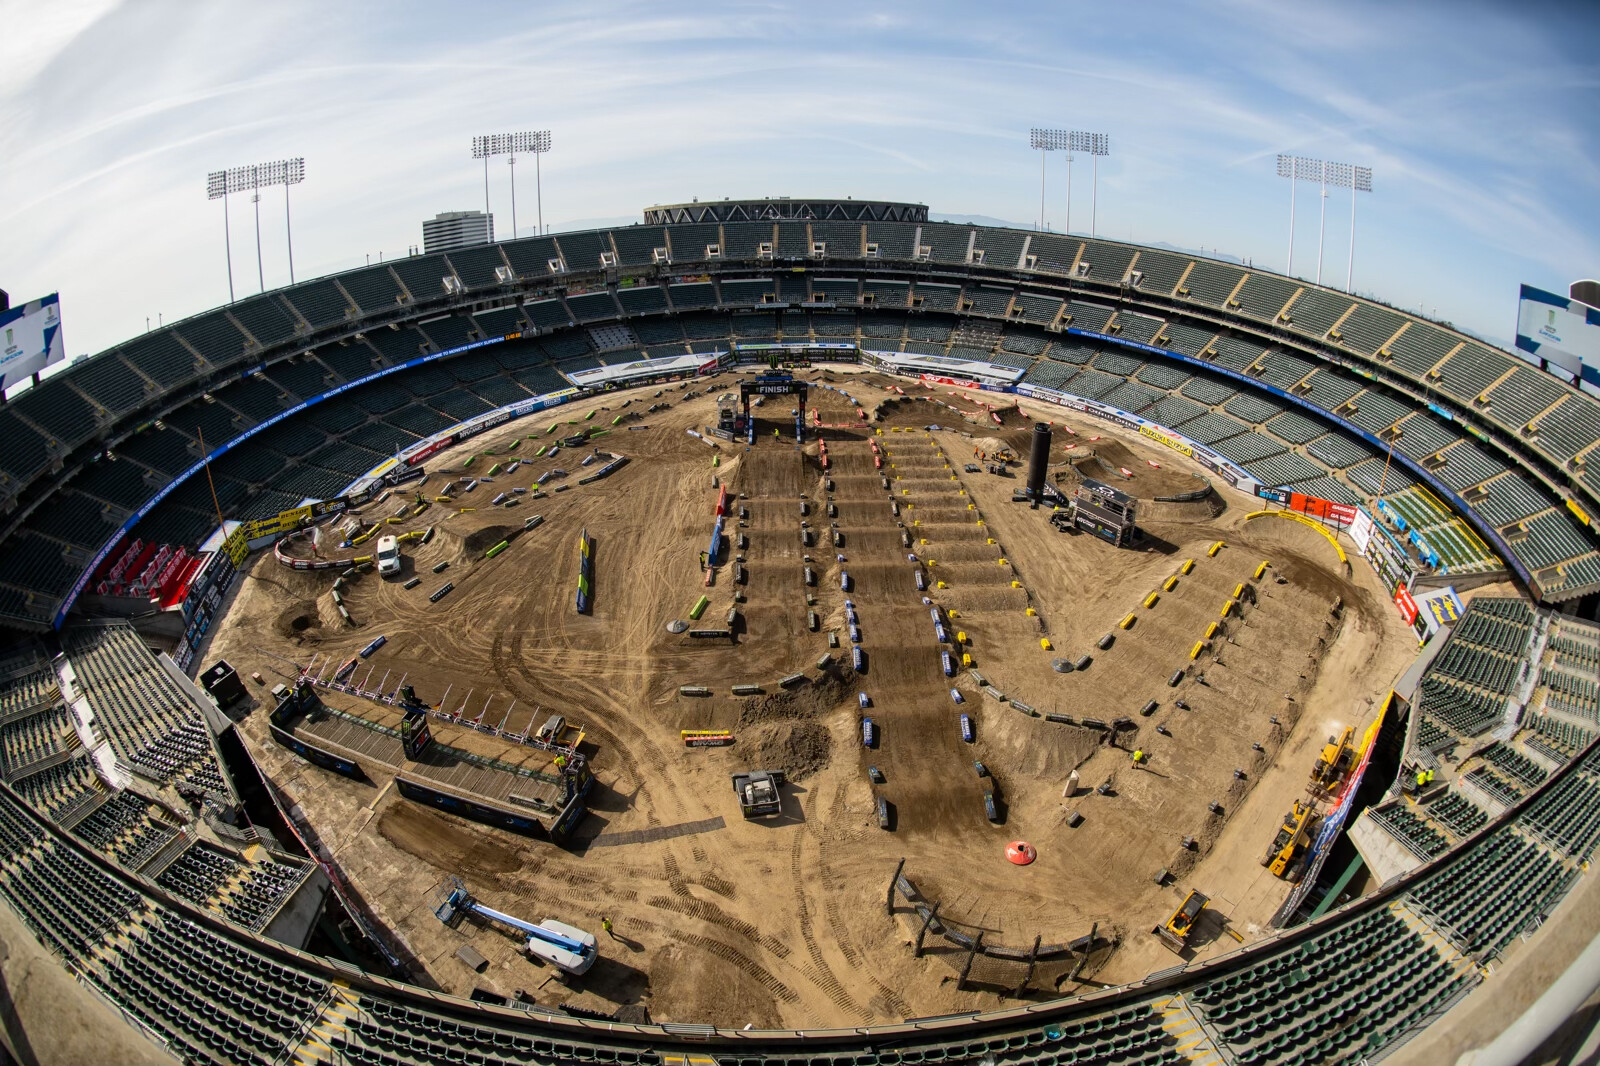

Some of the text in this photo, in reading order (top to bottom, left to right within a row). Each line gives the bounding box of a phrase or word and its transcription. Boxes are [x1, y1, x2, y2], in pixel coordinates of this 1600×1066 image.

[423, 352, 443, 362] WELCOME
[449, 345, 468, 355] MONSTER
[467, 341, 484, 350] ENERGY
[1081, 330, 1100, 339] WELCOME
[1107, 335, 1126, 345] MONSTER
[1126, 339, 1142, 348] ENERGY
[1141, 343, 1168, 355] SUPERCROSS
[323, 388, 341, 399] WELCOME
[347, 377, 367, 389] MONSTER
[366, 371, 382, 382] ENERGY
[381, 363, 407, 376] SUPERCROSS
[1183, 356, 1203, 366] WELCOME
[1208, 363, 1228, 374] MONSTER
[1227, 370, 1243, 380] ENERGY
[1243, 375, 1268, 390] SUPERCROSS
[227, 434, 246, 449] WELCOME
[250, 421, 268, 436] MONSTER
[268, 414, 284, 426] ENERGY
[283, 402, 308, 418] SUPERCROSS
[1141, 427, 1166, 442] SUZUKI
[1166, 438, 1191, 455] SUZUKI
[138, 501, 155, 517] WELCOME
[160, 483, 176, 497] MONSTER
[175, 472, 190, 484] ENERGY
[1260, 487, 1286, 497] GoPro
[280, 508, 309, 519] DUNLOP
[1332, 504, 1355, 514] GASGAS
